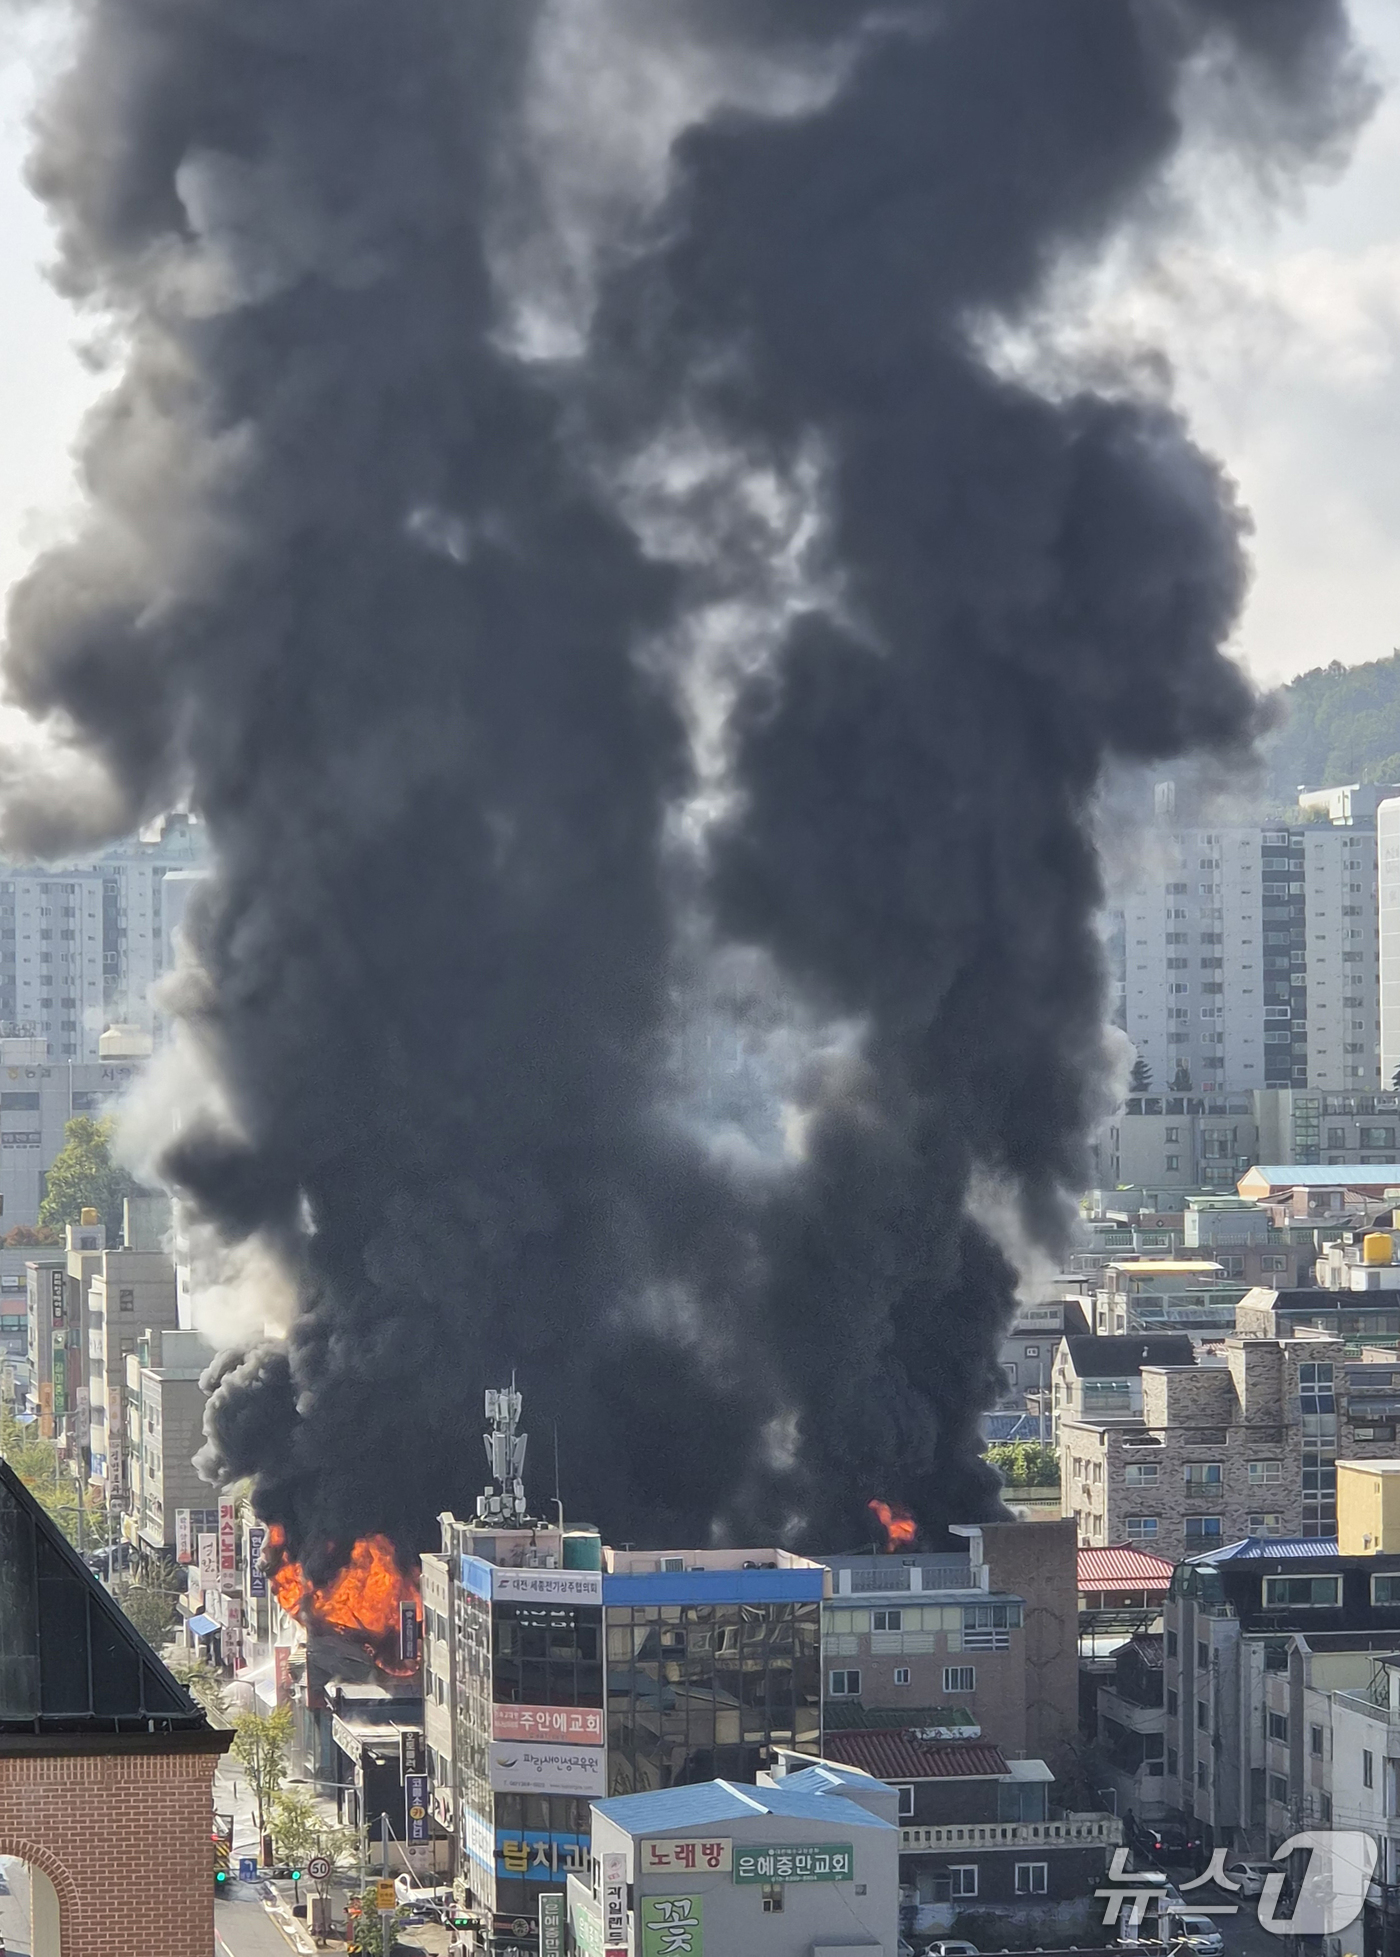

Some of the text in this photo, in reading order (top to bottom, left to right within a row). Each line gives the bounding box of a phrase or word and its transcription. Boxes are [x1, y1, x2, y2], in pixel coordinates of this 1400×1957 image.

[519, 1711, 600, 1734] 주안에교회
[523, 1753, 599, 1774] 파랑새인성교육원
[502, 1840, 591, 1873] 탑치과
[649, 1842, 725, 1869] 노래방
[738, 1853, 849, 1877] 은혜충만교회
[312, 1862, 327, 1874] 50
[646, 1898, 700, 1955] 꽃
